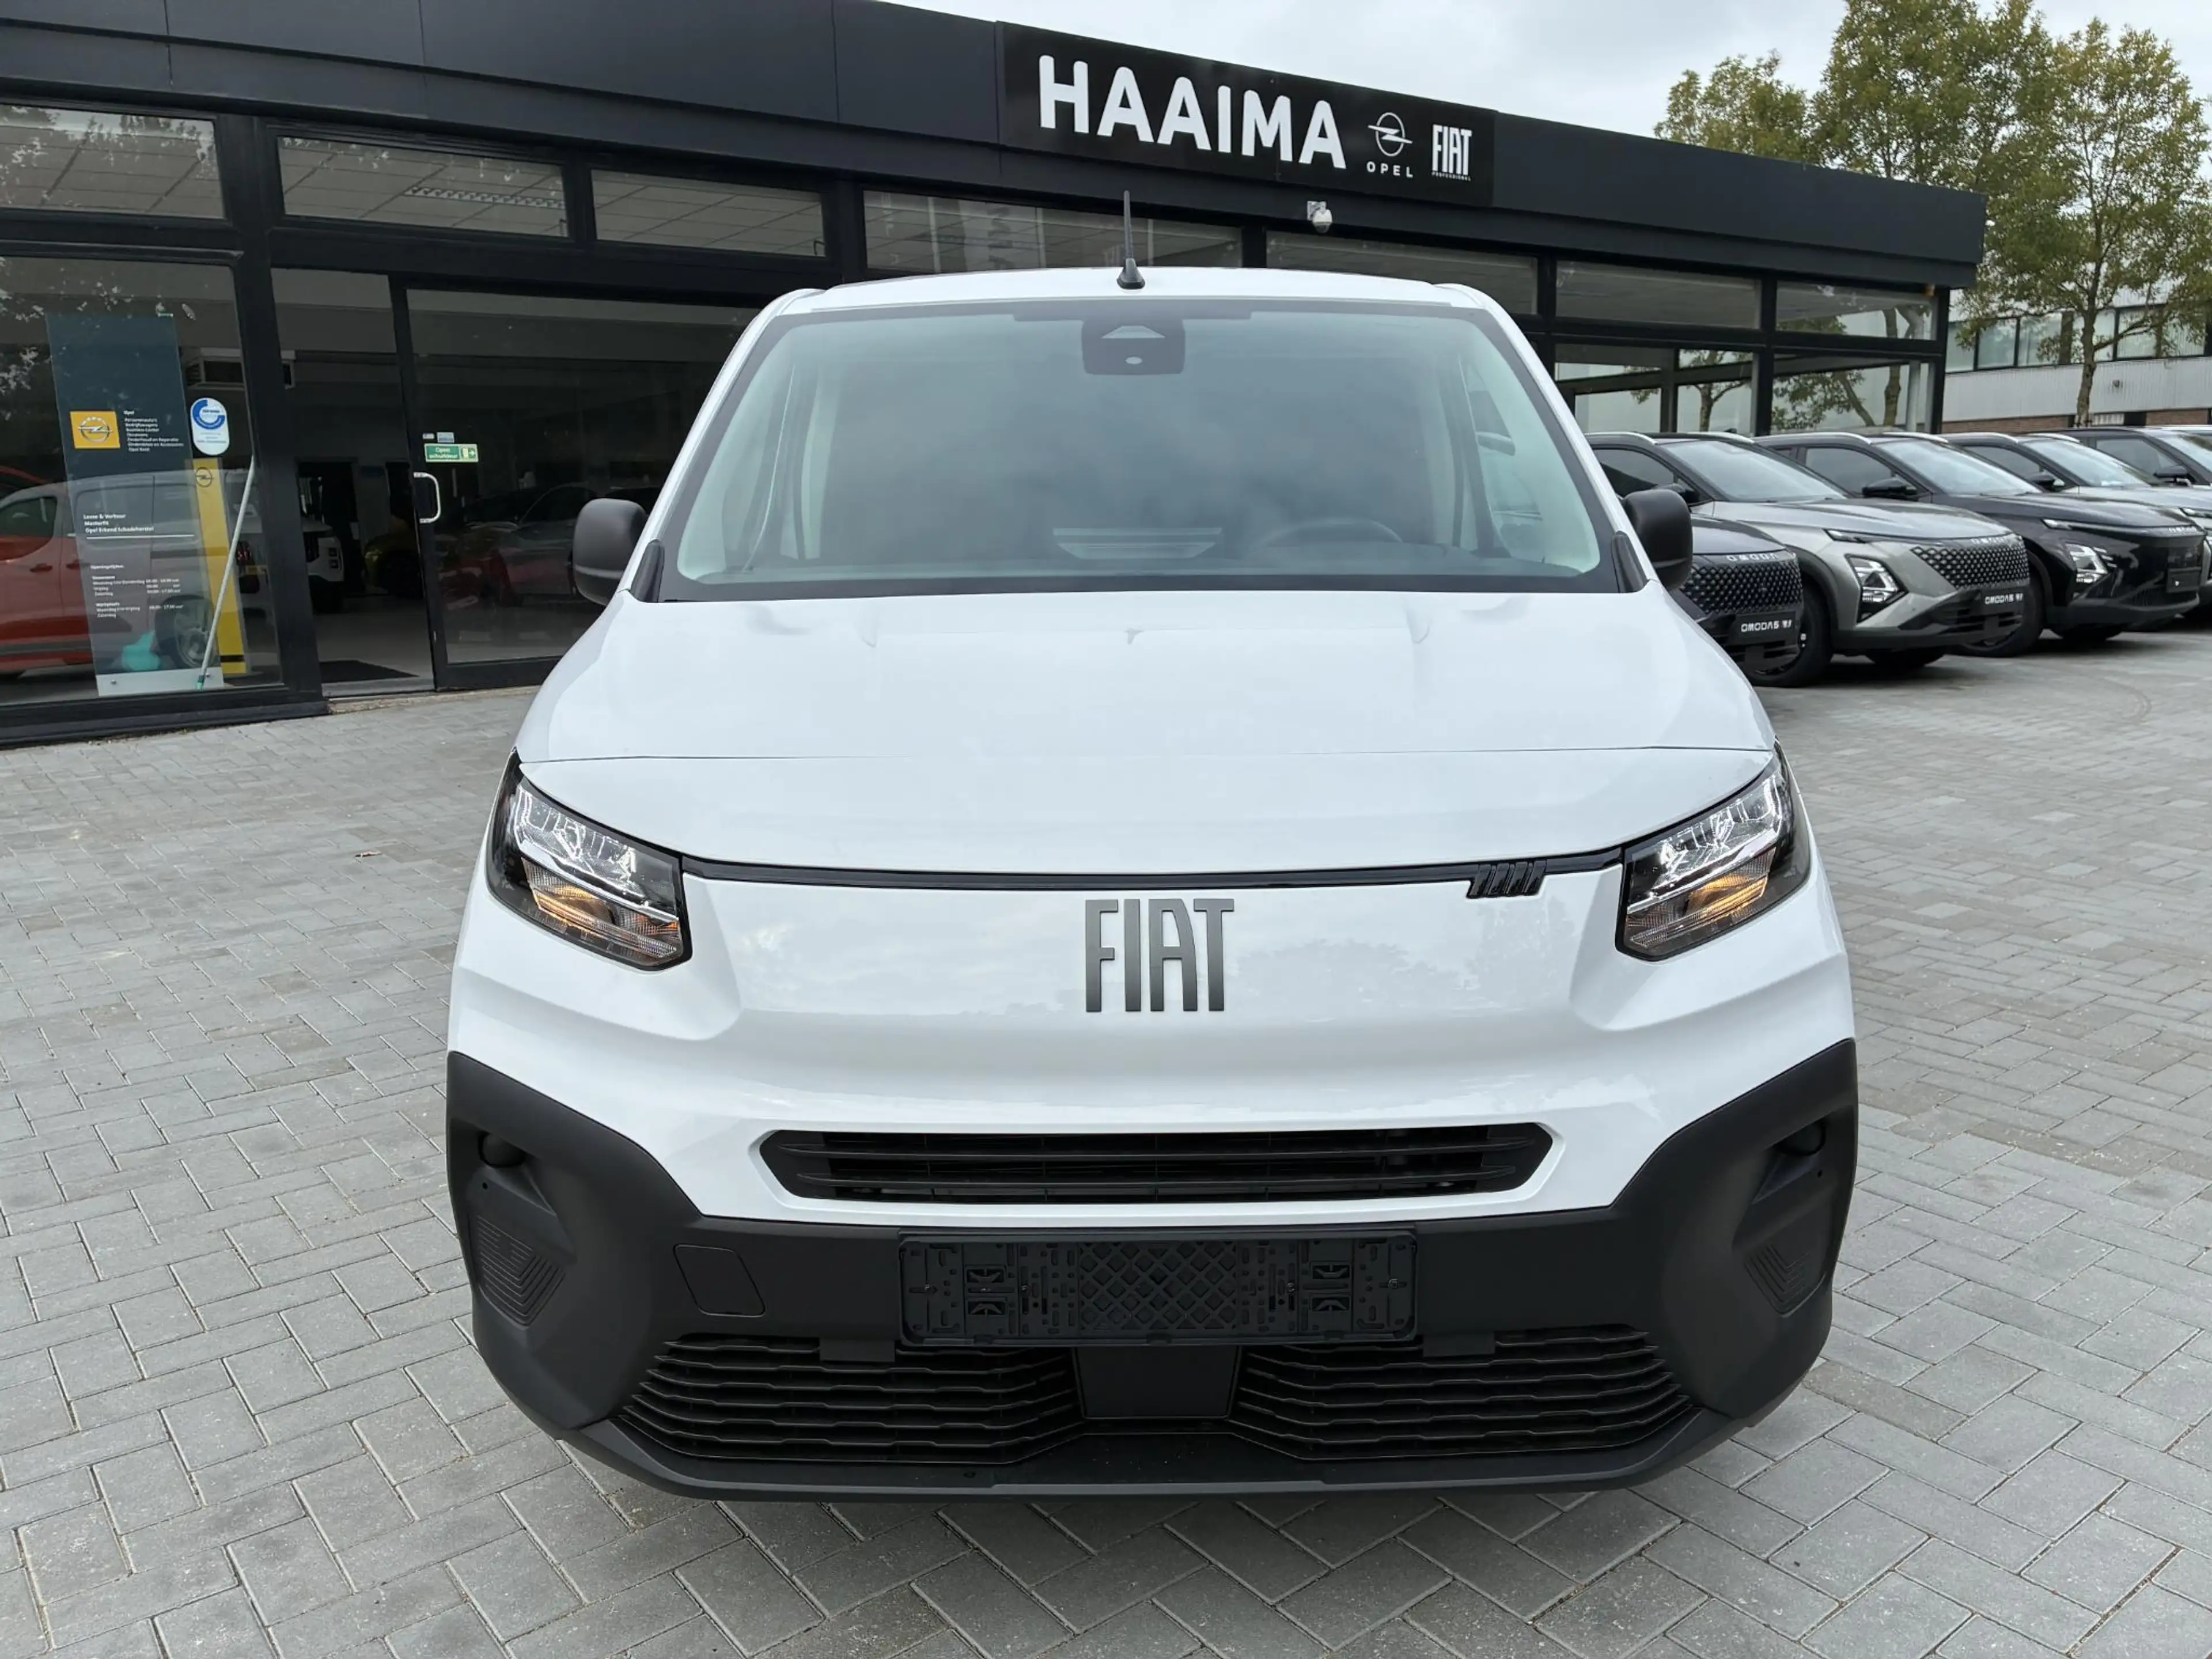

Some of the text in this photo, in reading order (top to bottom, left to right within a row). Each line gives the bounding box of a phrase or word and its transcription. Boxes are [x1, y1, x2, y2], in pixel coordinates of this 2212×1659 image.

[1039, 55, 1347, 169] HAAIMA
[1432, 124, 1472, 175] FIAT
[1366, 161, 1414, 179] OPEL
[1085, 898, 1234, 1012] FIAT
